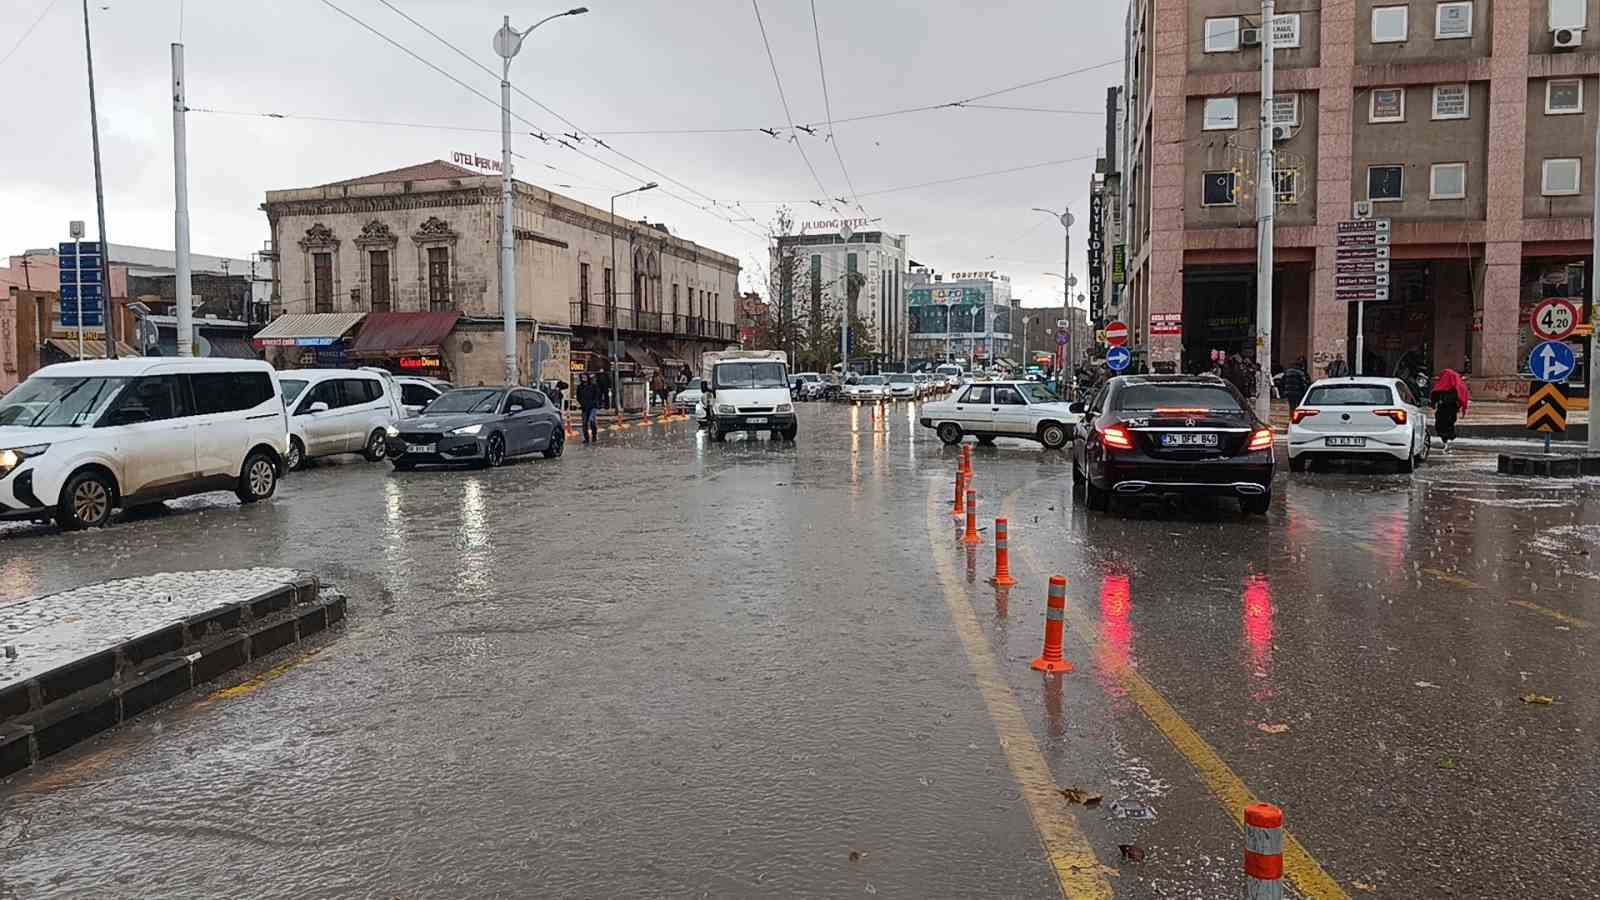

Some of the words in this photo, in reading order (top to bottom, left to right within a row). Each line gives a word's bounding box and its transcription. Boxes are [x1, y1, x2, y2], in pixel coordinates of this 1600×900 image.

[454, 153, 473, 165] OTEL
[1091, 274, 1102, 321] HOTEL
[1541, 309, 1554, 329] 4
[1167, 434, 1177, 444] 34
[1201, 433, 1217, 443] 840
